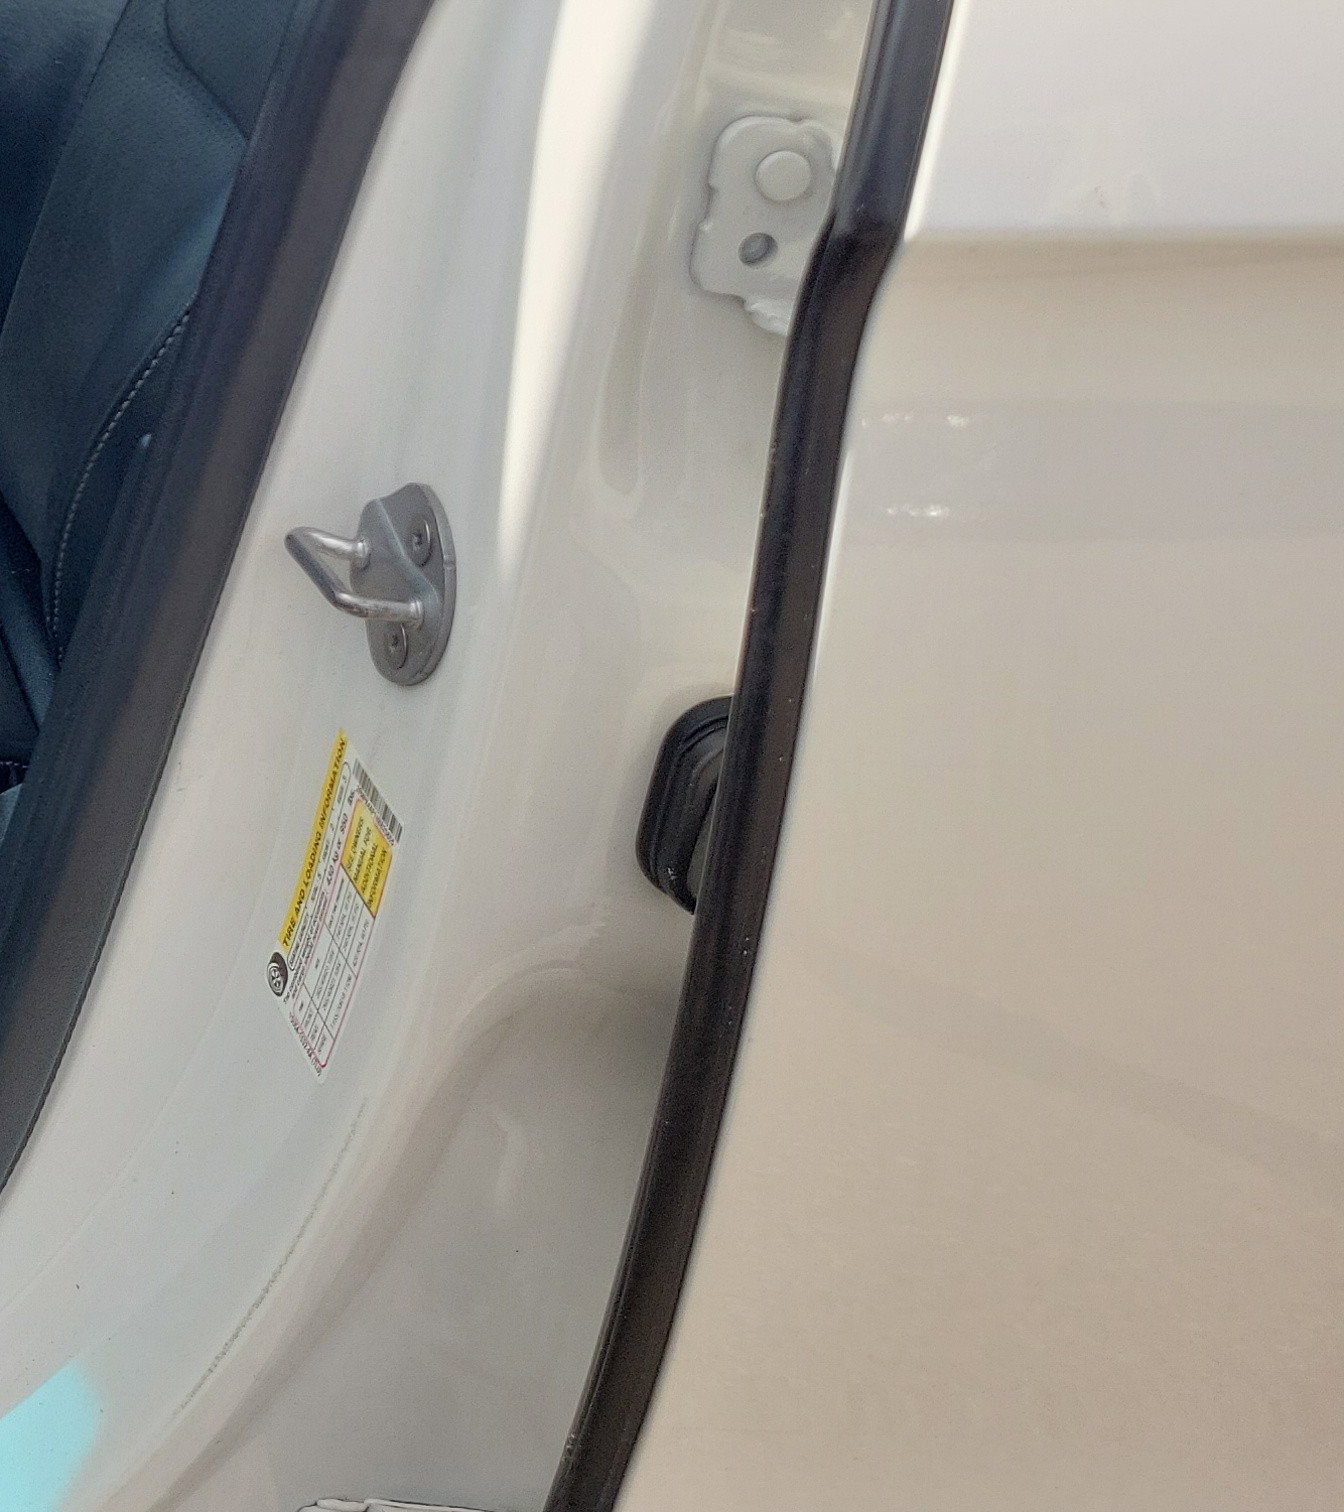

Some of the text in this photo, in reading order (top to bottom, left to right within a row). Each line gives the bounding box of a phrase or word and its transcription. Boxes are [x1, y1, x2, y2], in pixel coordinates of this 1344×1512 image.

[283, 737, 345, 946] TIRE AND LOADING INFORMATION
